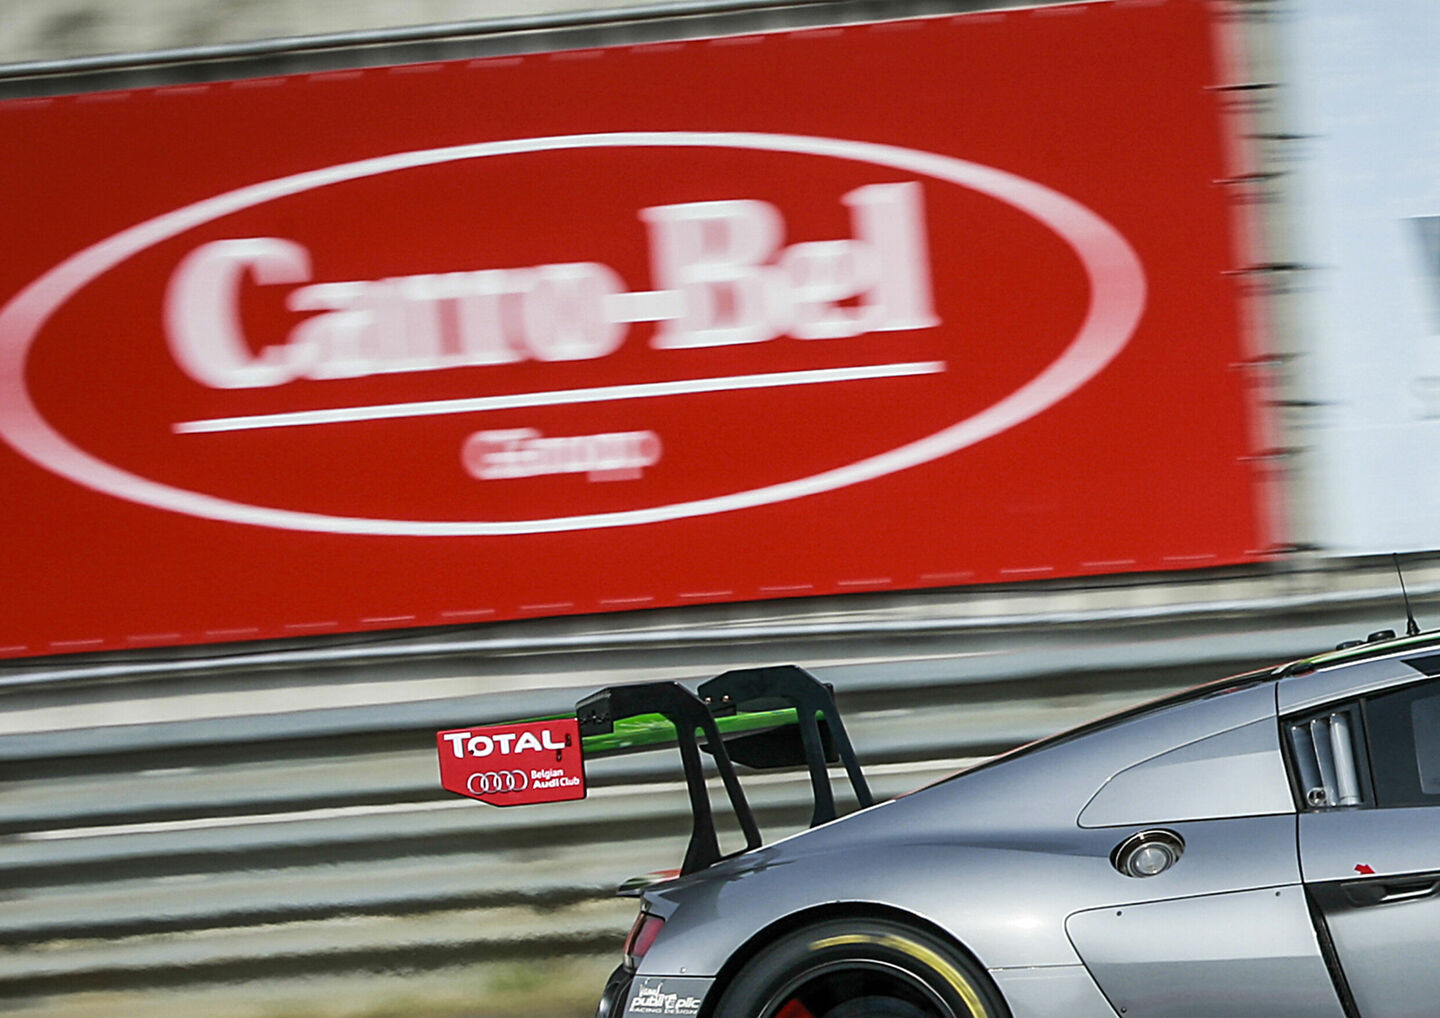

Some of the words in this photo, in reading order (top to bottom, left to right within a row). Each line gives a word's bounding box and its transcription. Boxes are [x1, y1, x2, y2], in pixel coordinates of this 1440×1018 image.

[443, 730, 566, 758] TOTAL
[531, 769, 564, 780] Belgian
[532, 778, 560, 789] Audi
[559, 776, 580, 786] Club
